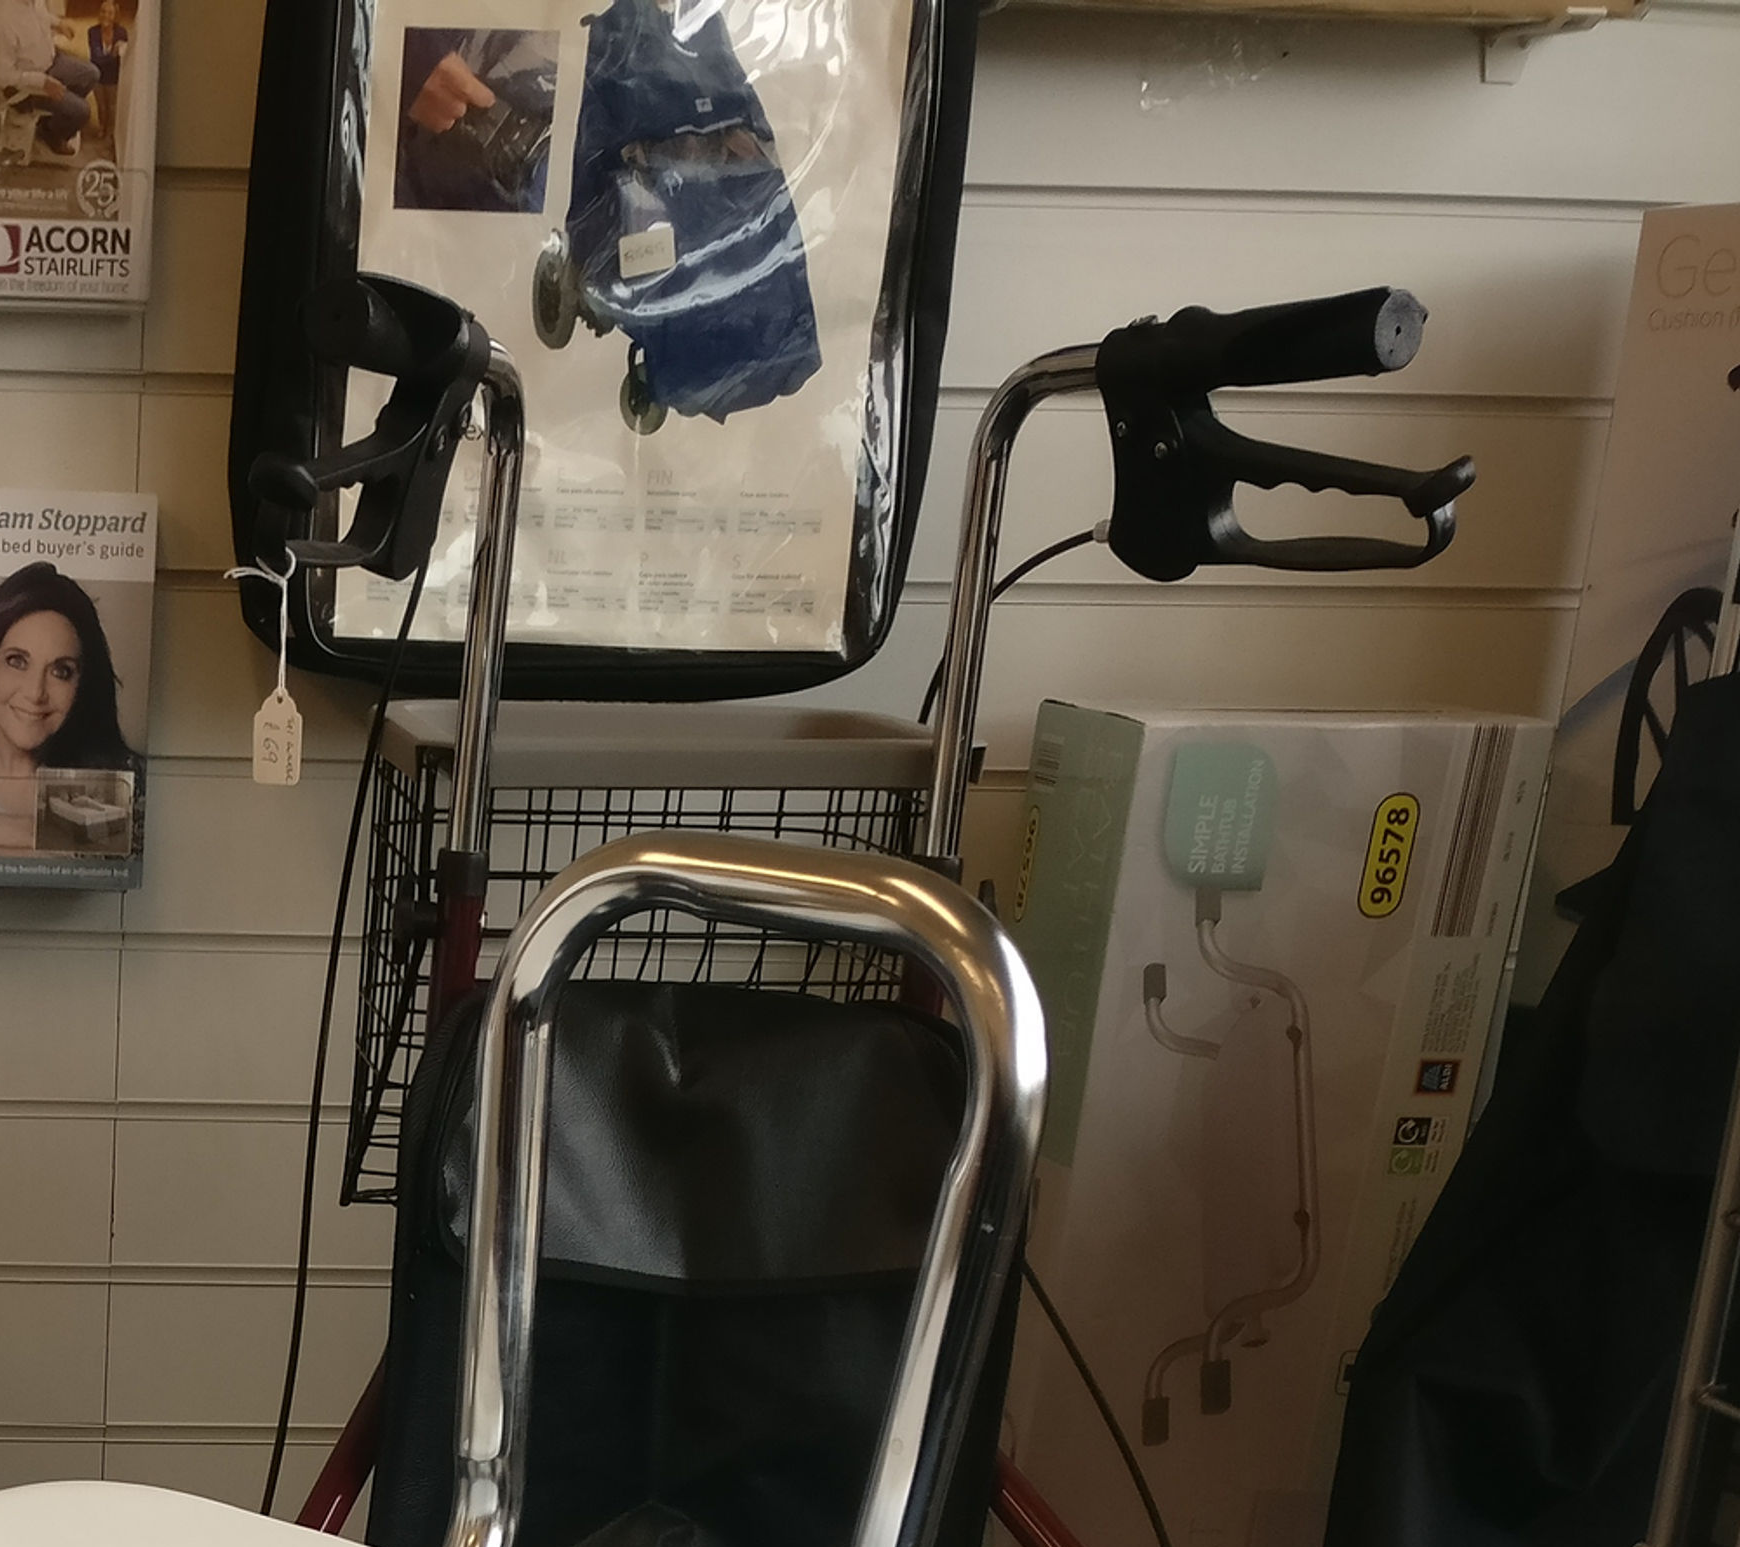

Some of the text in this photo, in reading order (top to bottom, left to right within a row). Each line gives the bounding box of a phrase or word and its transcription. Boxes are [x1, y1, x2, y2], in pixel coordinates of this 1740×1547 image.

[85, 169, 115, 207] 25
[24, 225, 131, 255] ACORN
[23, 256, 130, 278] STAIRLIFTS
[38, 508, 148, 536] Stoppard
[1, 538, 31, 554] bed
[36, 540, 96, 558] buyer's
[99, 542, 145, 560] guide
[1231, 759, 1267, 875] INSTALLATION
[1187, 794, 1219, 874] SIMPLE
[1369, 806, 1411, 906] 96578
[1439, 1063, 1453, 1091] ALDI
